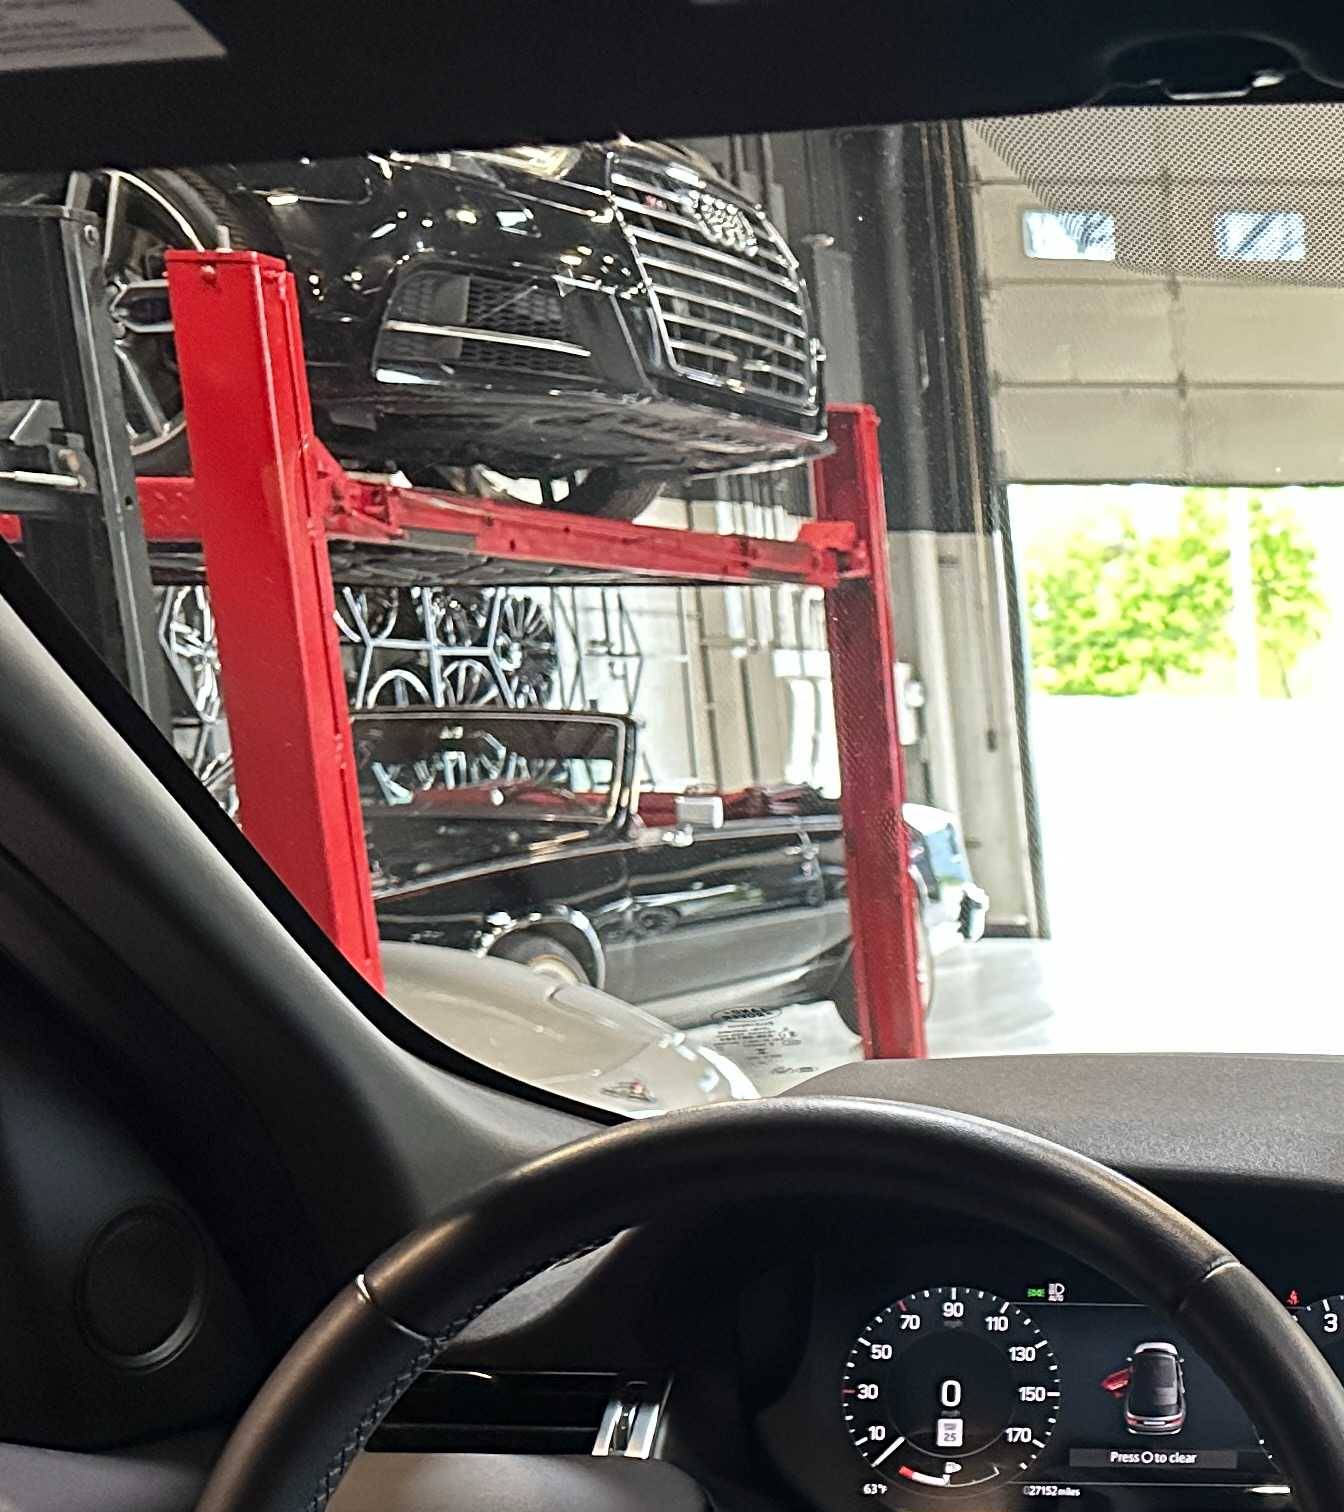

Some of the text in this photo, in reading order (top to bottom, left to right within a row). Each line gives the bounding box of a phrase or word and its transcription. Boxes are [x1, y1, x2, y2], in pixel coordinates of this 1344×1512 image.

[943, 1302, 964, 1317] 90
[900, 1314, 920, 1330] 70
[985, 1316, 1008, 1331] 110
[1323, 1313, 1338, 1333] 3
[871, 1344, 893, 1360] 50
[1009, 1346, 1036, 1362] 130
[857, 1384, 879, 1399] 30
[941, 1380, 961, 1407] 0
[1019, 1386, 1046, 1402] 150
[868, 1425, 886, 1440] 10
[944, 1432, 957, 1442] 25
[1006, 1427, 1032, 1443] 170
[1110, 1451, 1197, 1464] Press to clear
